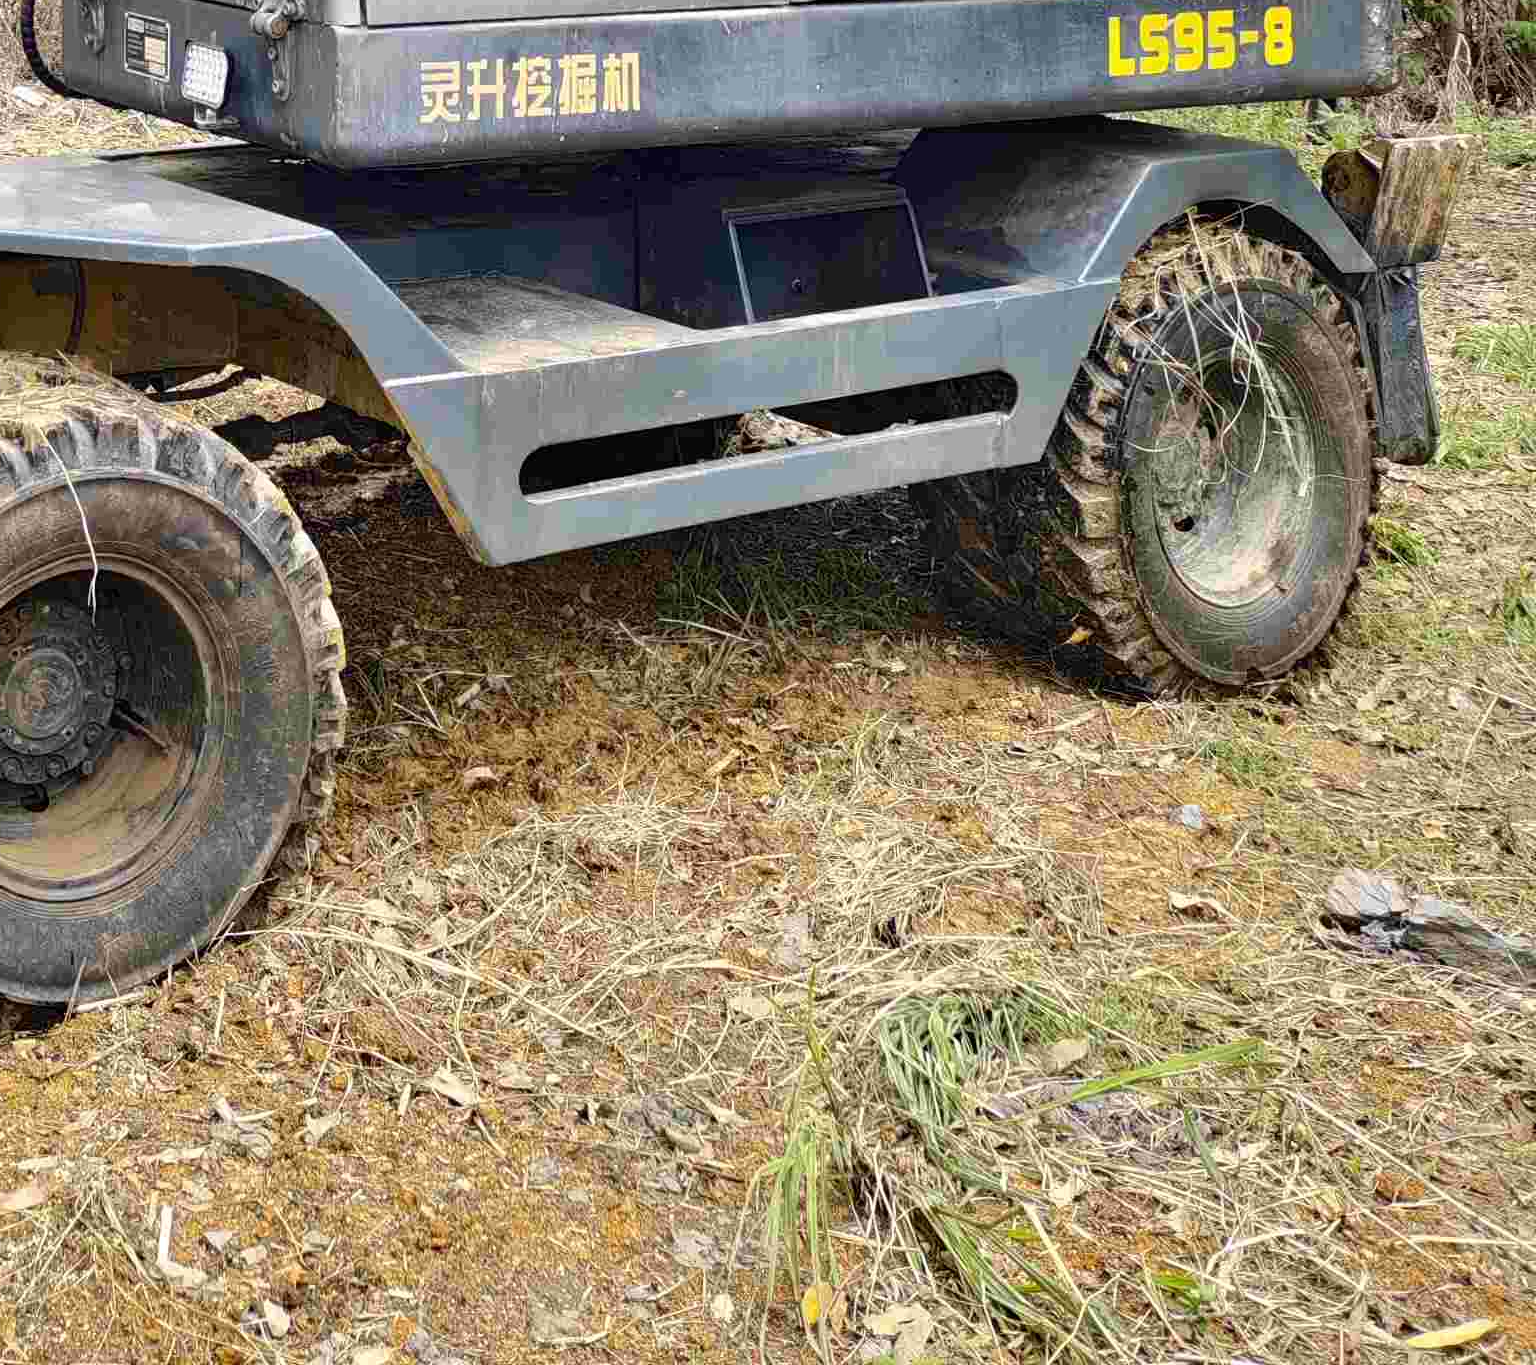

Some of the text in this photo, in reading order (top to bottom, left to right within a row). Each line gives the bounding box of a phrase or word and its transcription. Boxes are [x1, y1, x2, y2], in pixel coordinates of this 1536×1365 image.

[1107, 6, 1294, 77] LS95-8
[418, 52, 642, 125] 灵升挖掘机
